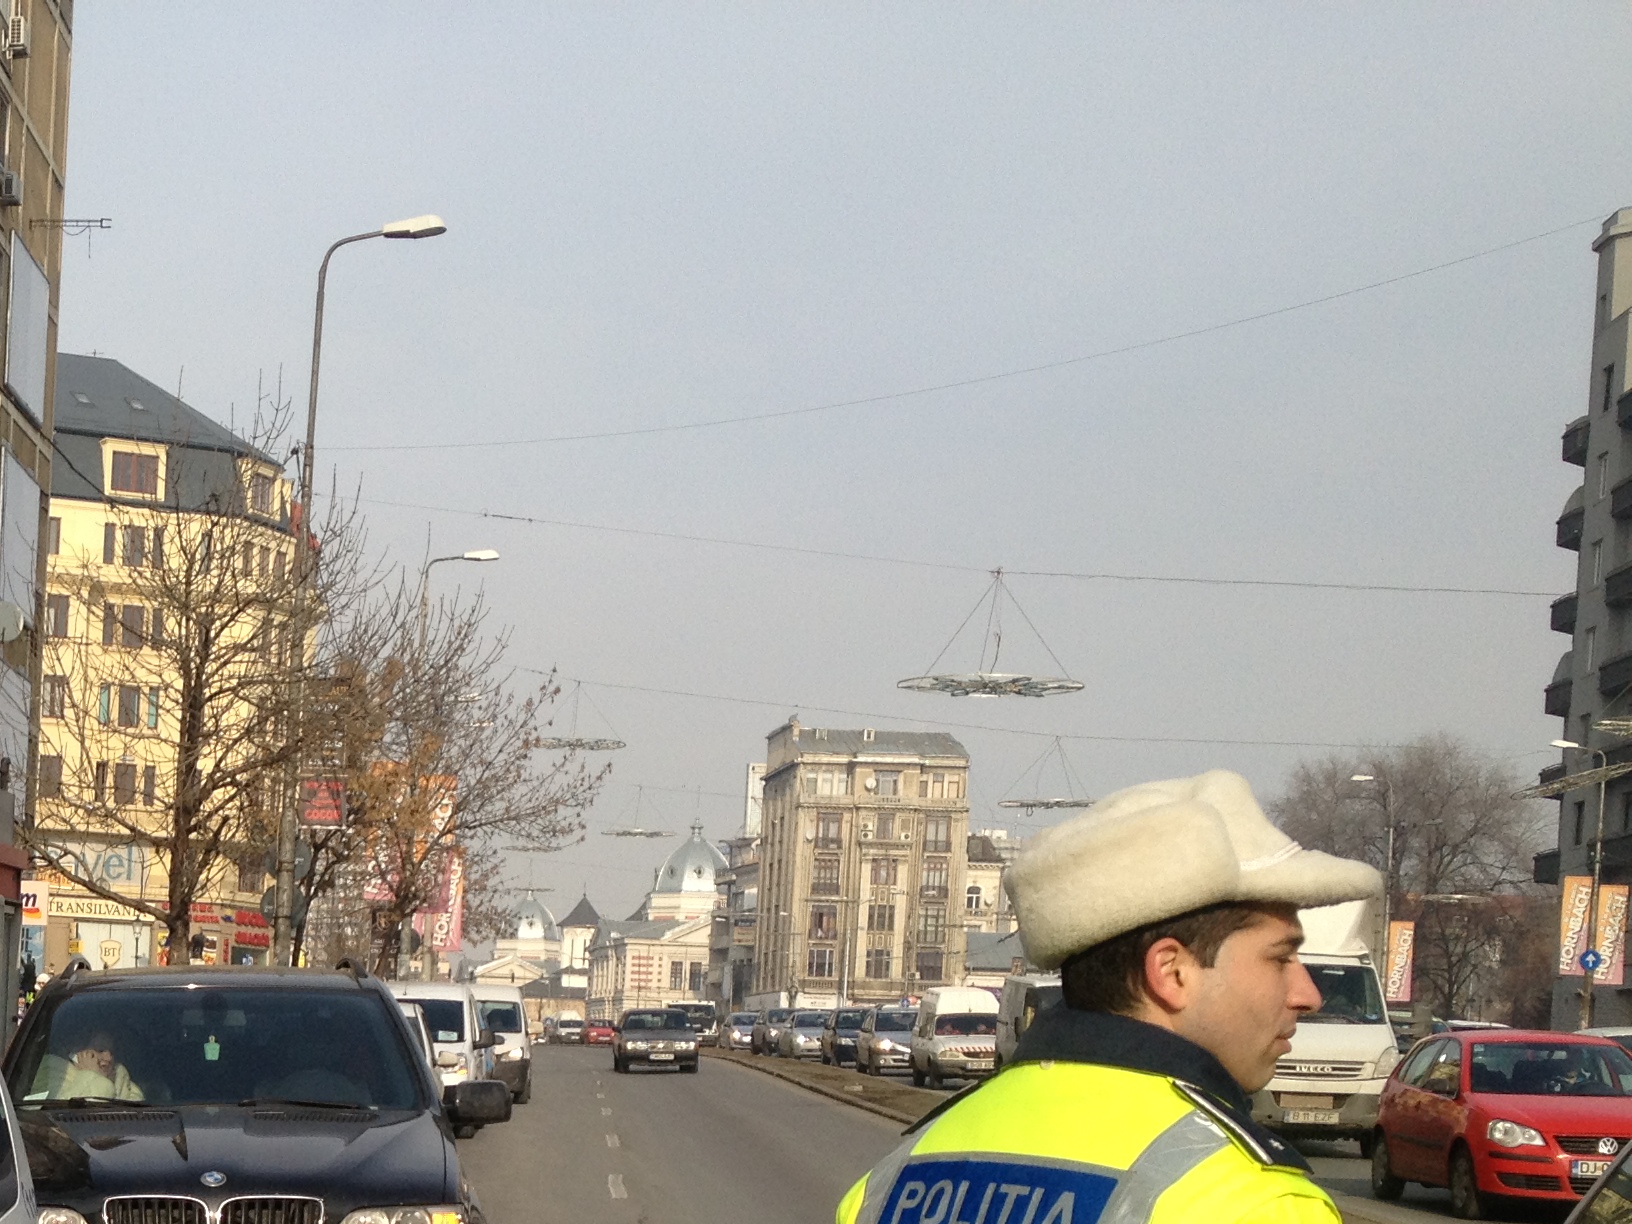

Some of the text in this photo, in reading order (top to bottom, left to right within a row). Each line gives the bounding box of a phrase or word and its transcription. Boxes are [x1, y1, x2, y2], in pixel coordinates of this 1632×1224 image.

[104, 947, 117, 957] BT
[1560, 886, 1592, 971] HORNBACH
[1594, 895, 1627, 980] HORNBACH
[1386, 929, 1414, 998] HORNBACH
[1296, 1065, 1332, 1073] IVECO
